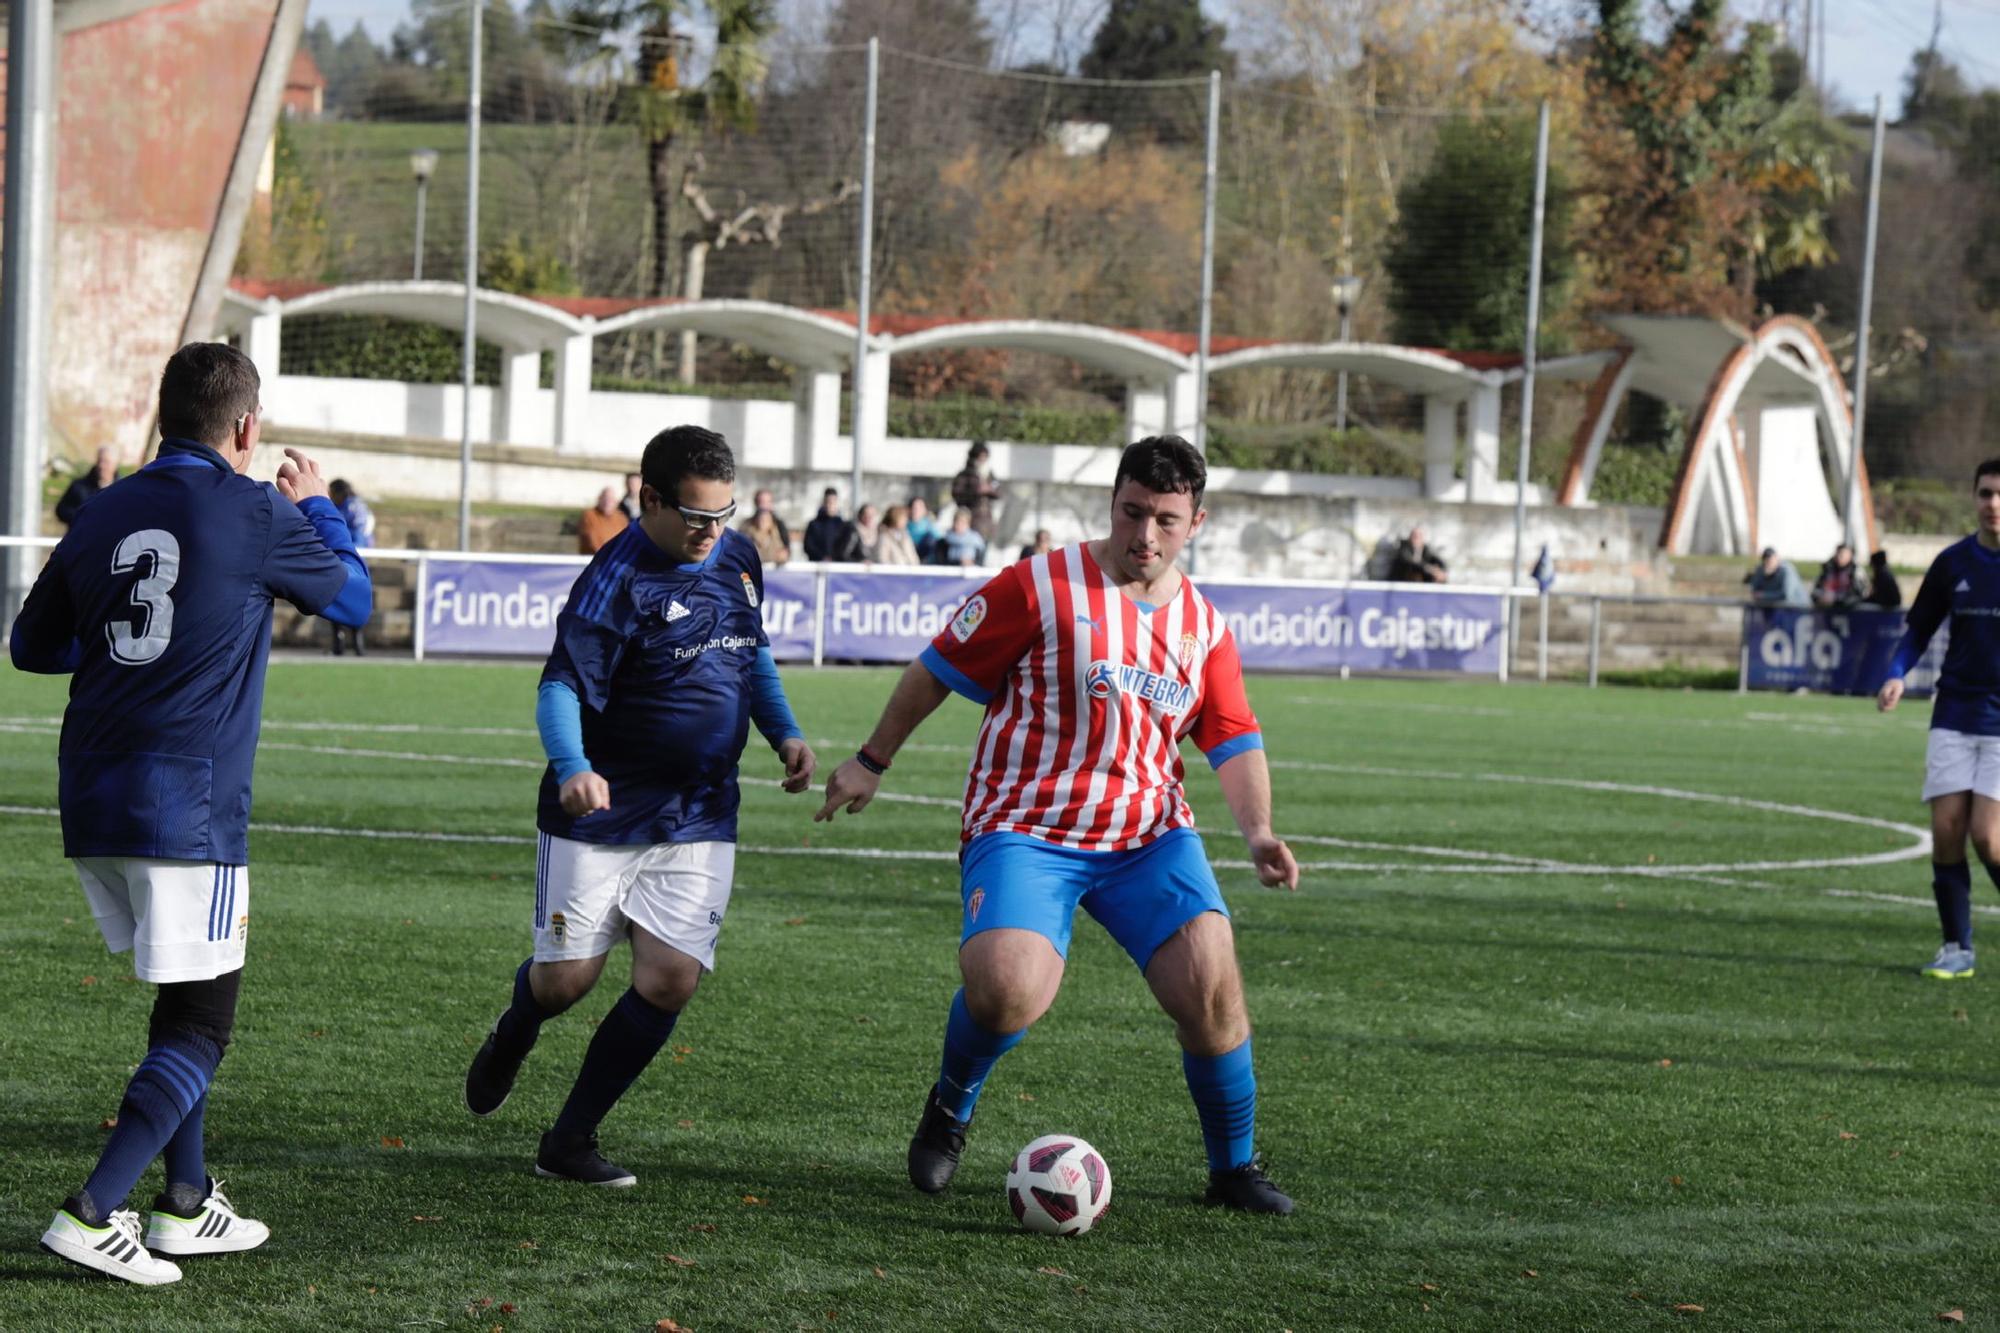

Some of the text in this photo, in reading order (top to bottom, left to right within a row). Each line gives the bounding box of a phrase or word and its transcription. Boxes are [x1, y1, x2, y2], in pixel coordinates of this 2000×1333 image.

[105, 528, 181, 666] 3
[1223, 602, 1493, 659] ndación Cajastur
[1760, 613, 1843, 671] afa
[1119, 666, 1191, 709] INTEGRA
